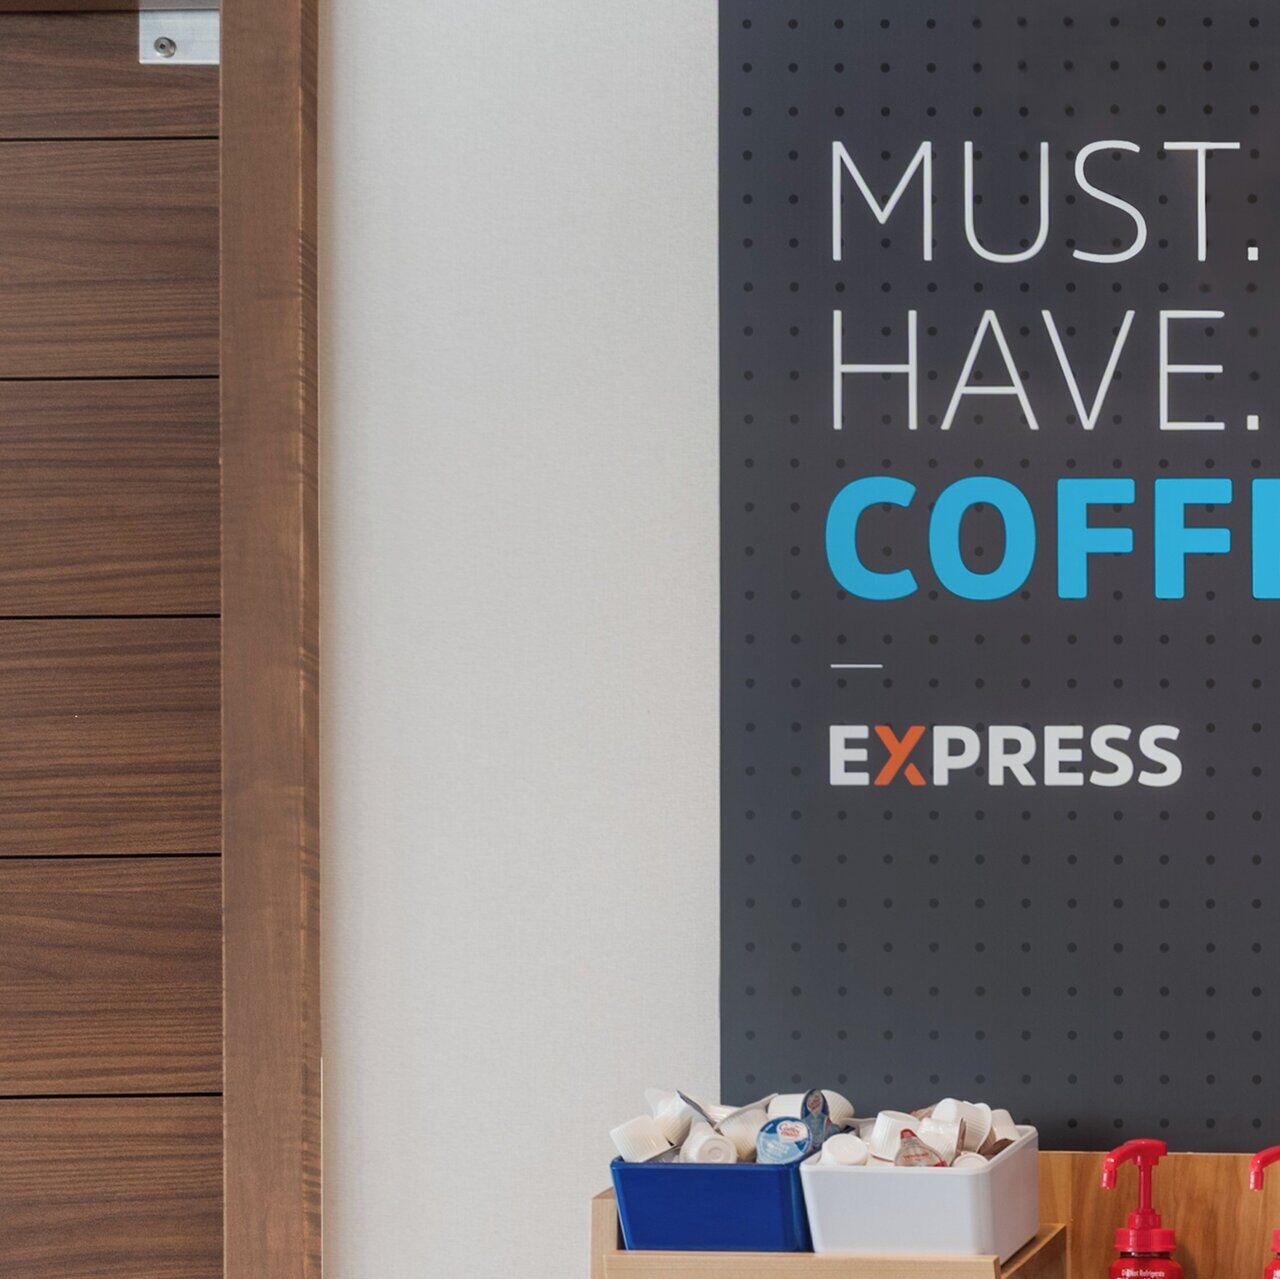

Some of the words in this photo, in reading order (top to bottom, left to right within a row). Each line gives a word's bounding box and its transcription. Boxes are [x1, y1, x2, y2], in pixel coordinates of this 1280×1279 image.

[832, 139, 1259, 264] MUST.
[833, 309, 1259, 431] HAVE.
[829, 724, 1183, 787] EXPRESS
